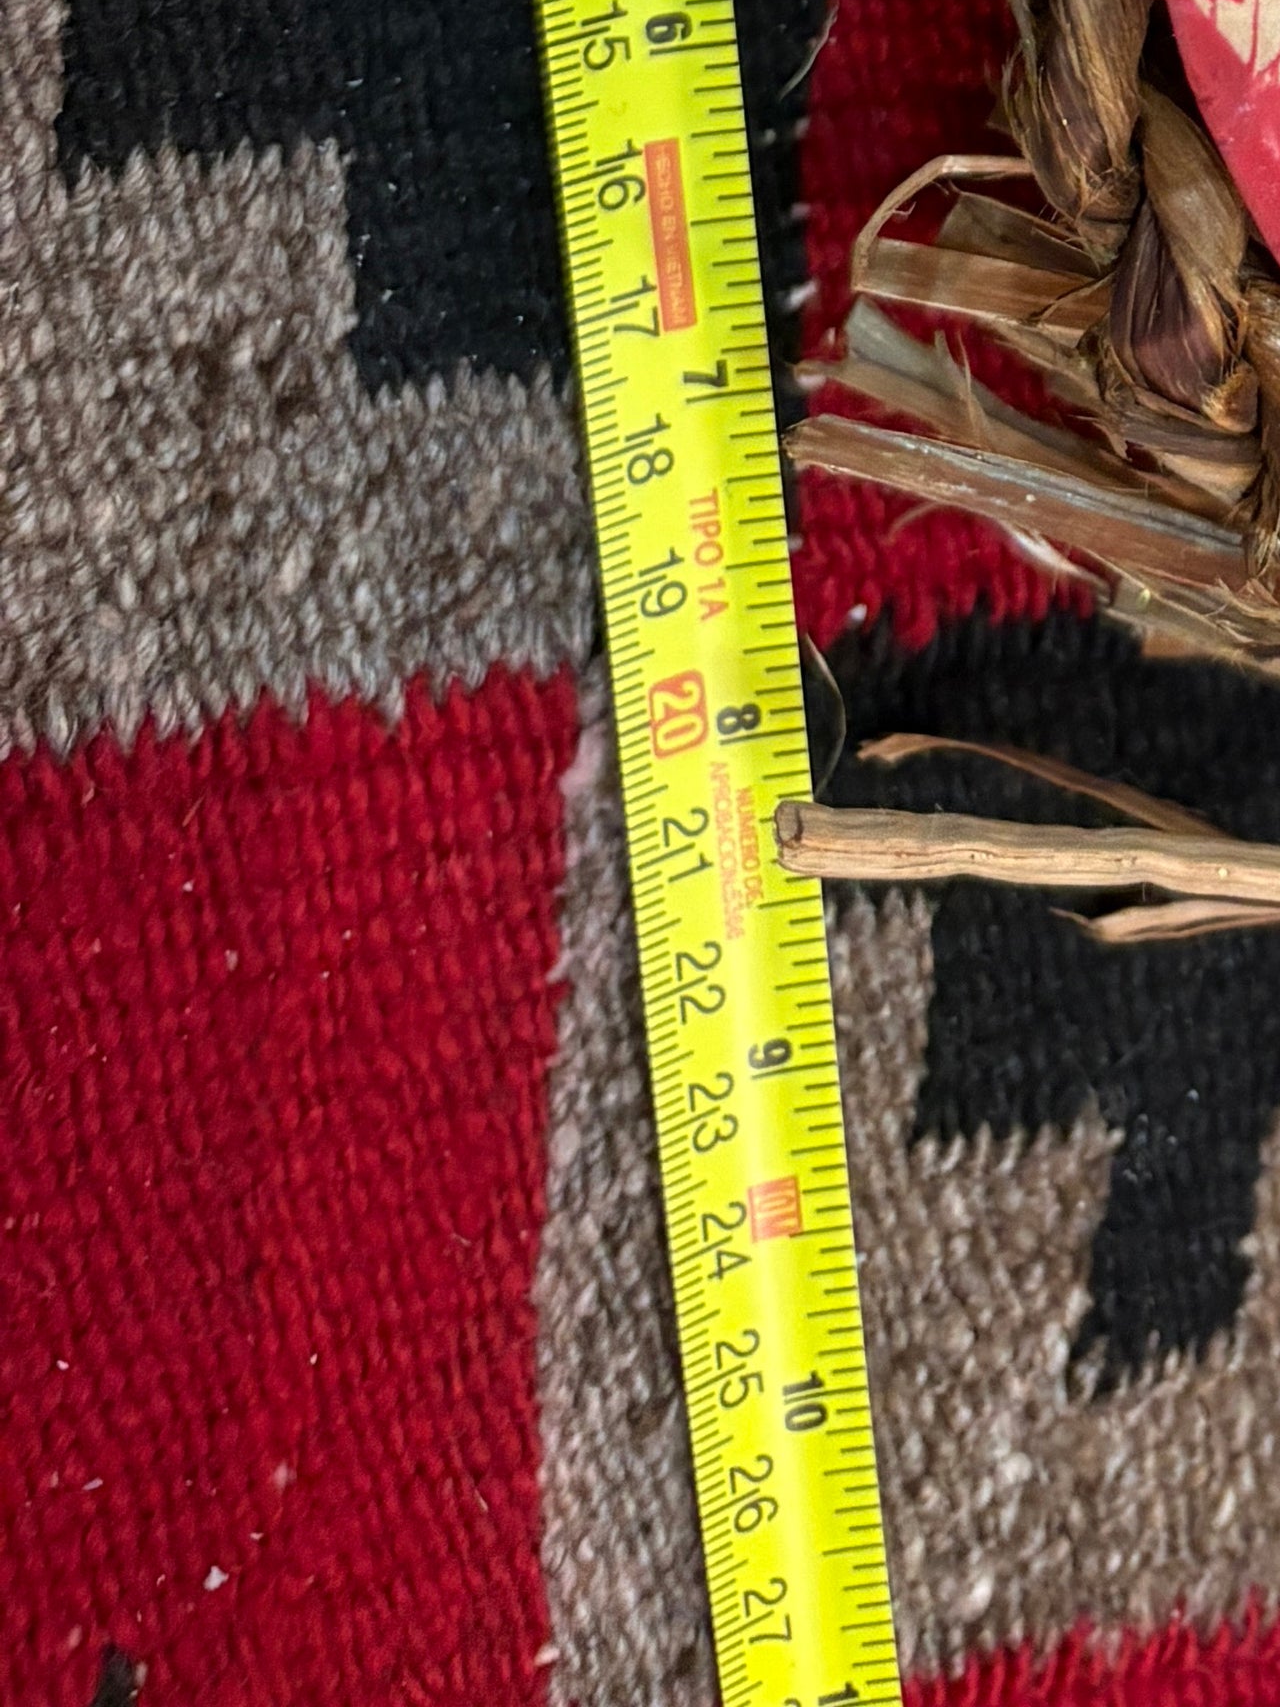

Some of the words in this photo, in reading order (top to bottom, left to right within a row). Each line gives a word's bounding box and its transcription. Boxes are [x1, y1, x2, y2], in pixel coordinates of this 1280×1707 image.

[645, 11, 693, 44] 6
[596, 139, 647, 212] 16
[610, 274, 660, 338] 17
[683, 360, 729, 388] 7
[624, 412, 675, 485] 18
[689, 487, 724, 567] TIPO
[638, 547, 688, 619] 19
[652, 681, 702, 751] 20
[716, 703, 762, 735] 8
[662, 807, 714, 883] 21
[675, 940, 726, 1025] 22
[748, 1037, 793, 1069] 9
[688, 1072, 739, 1153] 23
[701, 1201, 752, 1281] 24
[715, 1328, 764, 1408] 25
[783, 1370, 828, 1432] 10
[729, 1454, 779, 1533] 26
[743, 1577, 792, 1645] 27
